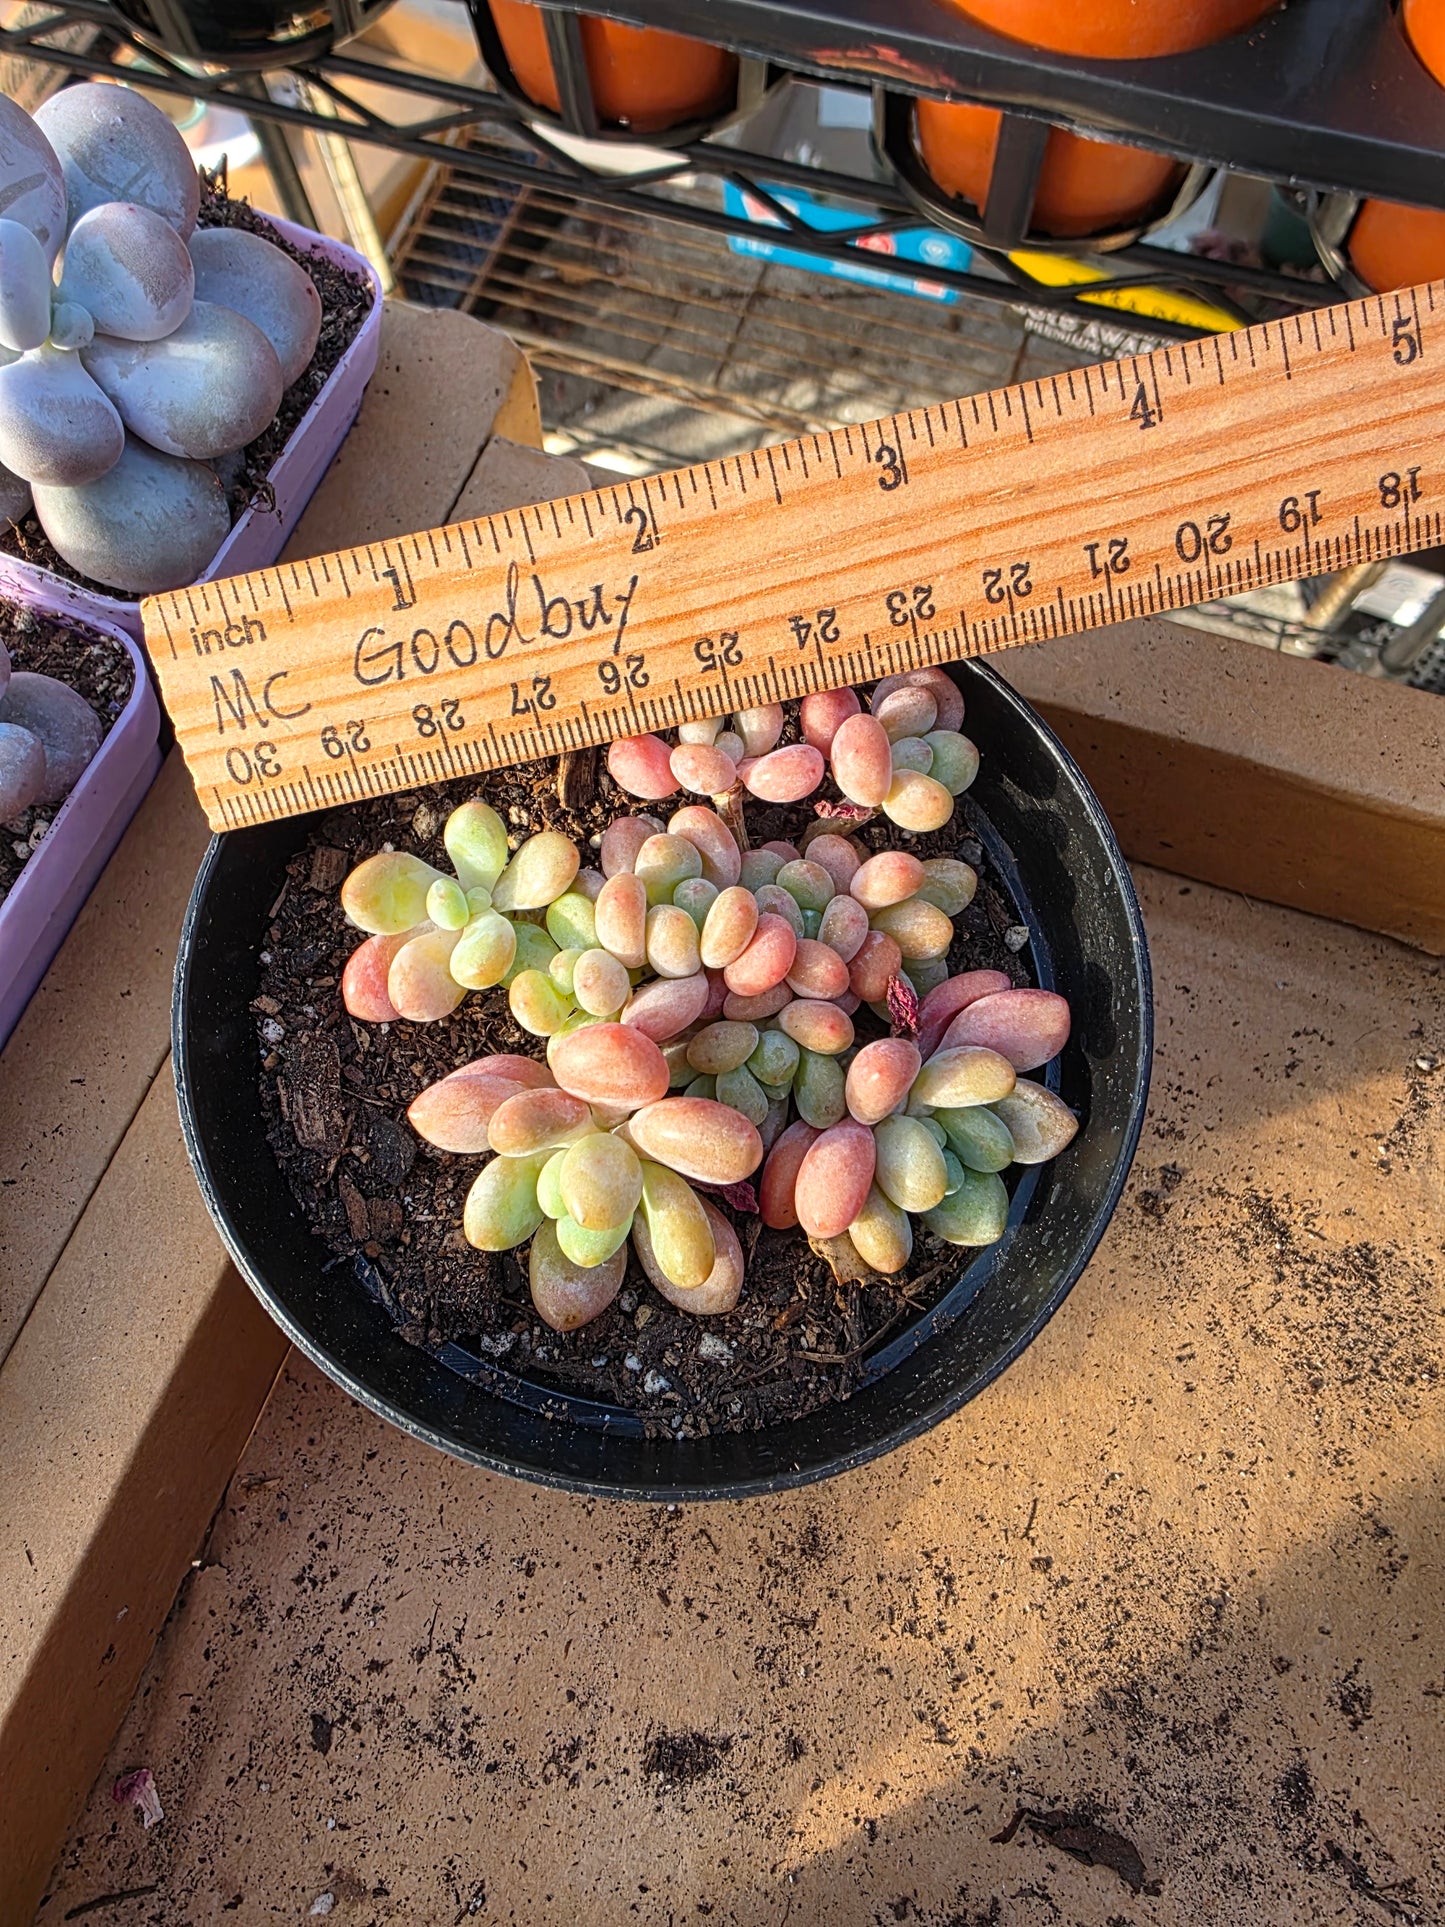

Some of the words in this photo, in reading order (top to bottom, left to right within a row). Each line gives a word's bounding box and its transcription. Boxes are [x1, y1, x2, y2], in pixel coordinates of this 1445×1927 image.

[190, 614, 267, 657] inch
[382, 566, 413, 612] 1
[624, 506, 654, 555] 2
[875, 445, 901, 491] 3
[1129, 381, 1156, 430] 4
[1392, 316, 1418, 366] 5
[1378, 466, 1424, 508] 18
[1279, 489, 1323, 533] 19
[1083, 537, 1131, 580] 21
[1175, 512, 1233, 564] 20
[982, 561, 1033, 604] 22
[885, 584, 936, 627] 23
[788, 607, 841, 650] 24
[597, 653, 651, 695] 26
[693, 631, 744, 674] 25
[209, 667, 312, 735] MC
[411, 697, 466, 738] 28
[510, 675, 557, 717] 27
[320, 719, 372, 760] 29
[225, 740, 282, 785] 30
